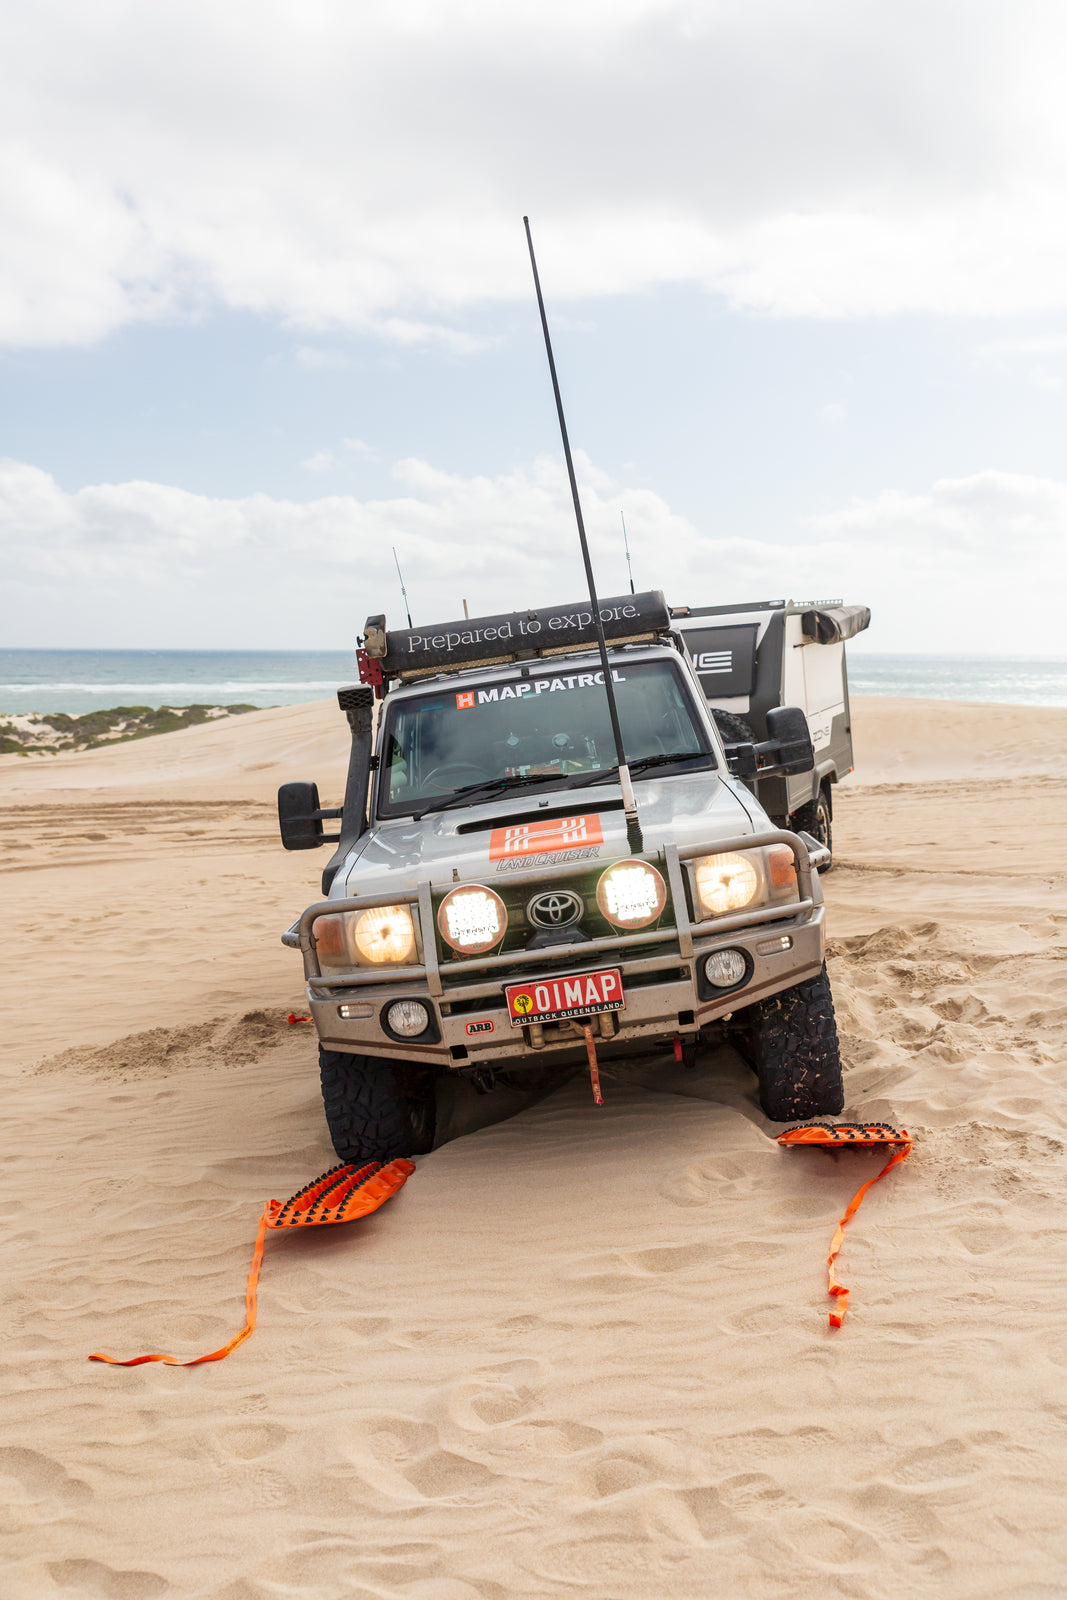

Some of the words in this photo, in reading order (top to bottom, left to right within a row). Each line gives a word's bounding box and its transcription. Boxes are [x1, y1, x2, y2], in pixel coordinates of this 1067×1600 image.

[408, 621, 513, 653] Prepared
[517, 618, 542, 635] to
[478, 683, 531, 704] MAP
[534, 670, 626, 694] PATROL
[496, 846, 601, 872] LANDCRUISER
[515, 1012, 557, 1026] OUTBACK
[561, 1002, 620, 1017] QUEENSLAND
[469, 1022, 492, 1034] ARB
